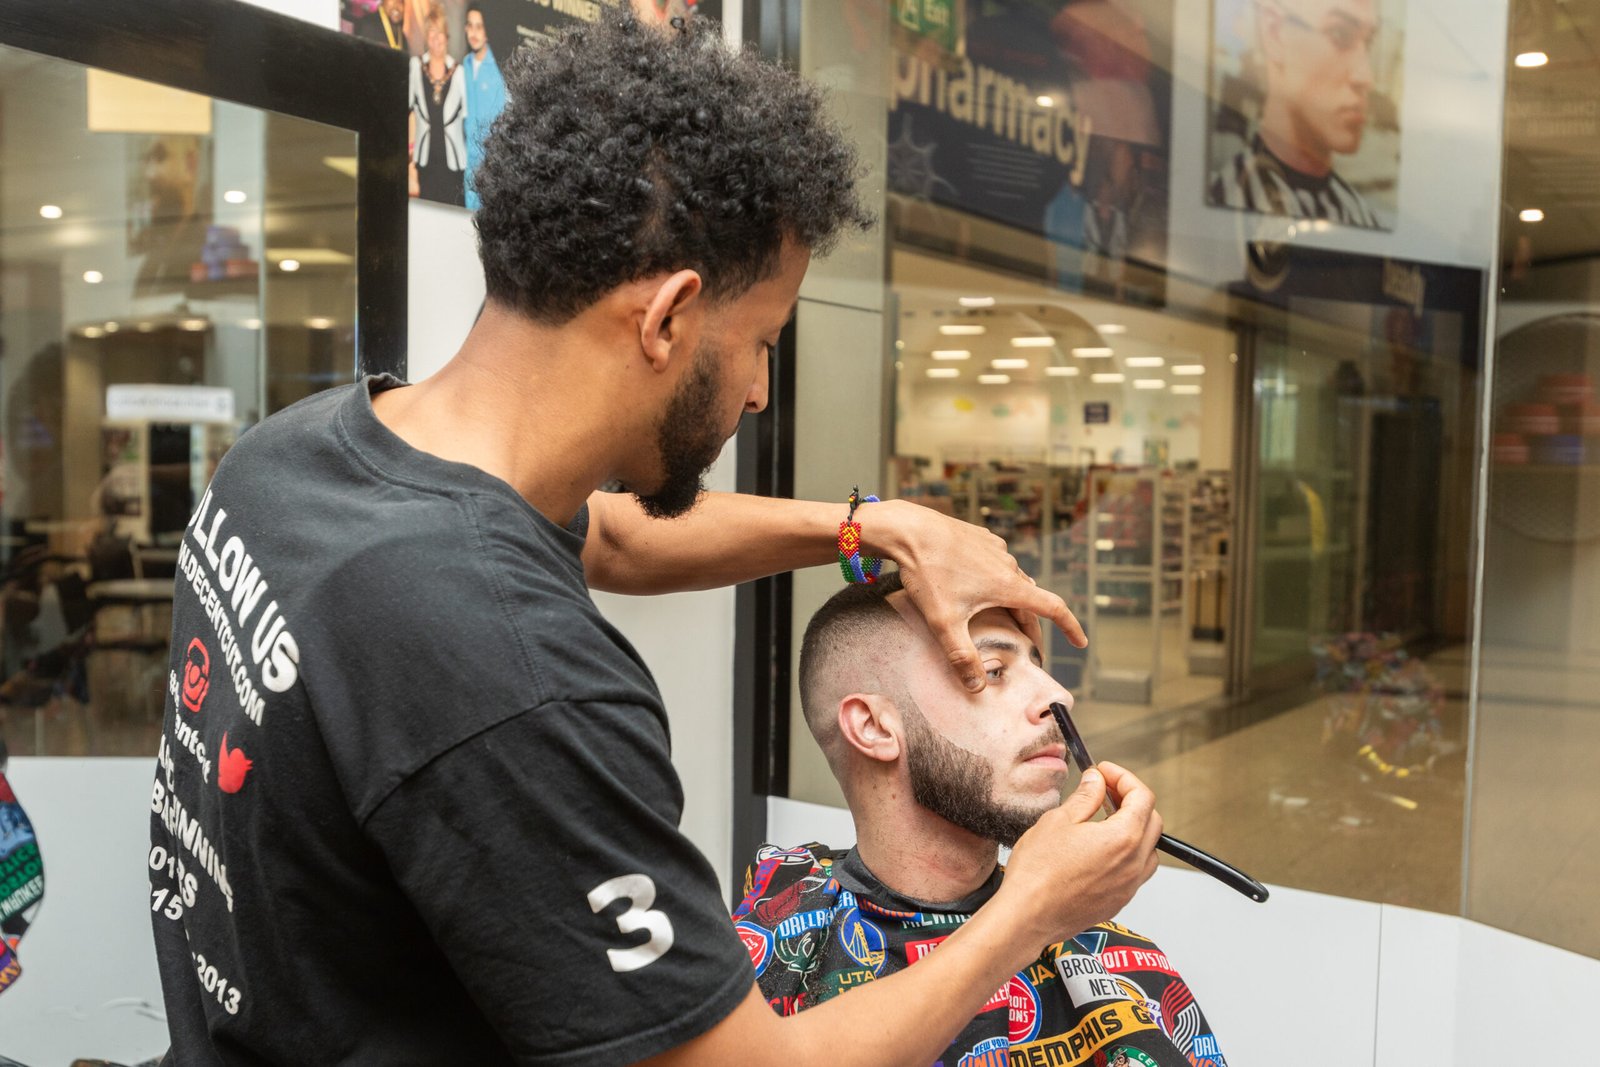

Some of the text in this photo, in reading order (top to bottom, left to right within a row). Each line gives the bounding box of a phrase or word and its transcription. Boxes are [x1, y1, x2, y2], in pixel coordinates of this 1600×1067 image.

[889, 50, 1092, 187] pharmacy
[188, 484, 300, 693] LLOW US
[587, 873, 675, 973] 3
[197, 954, 242, 1015] 2013
[1088, 978, 1128, 997] NETS
[974, 1041, 990, 1056] NEW
[1008, 1008, 1123, 1067] MEMPHIS
